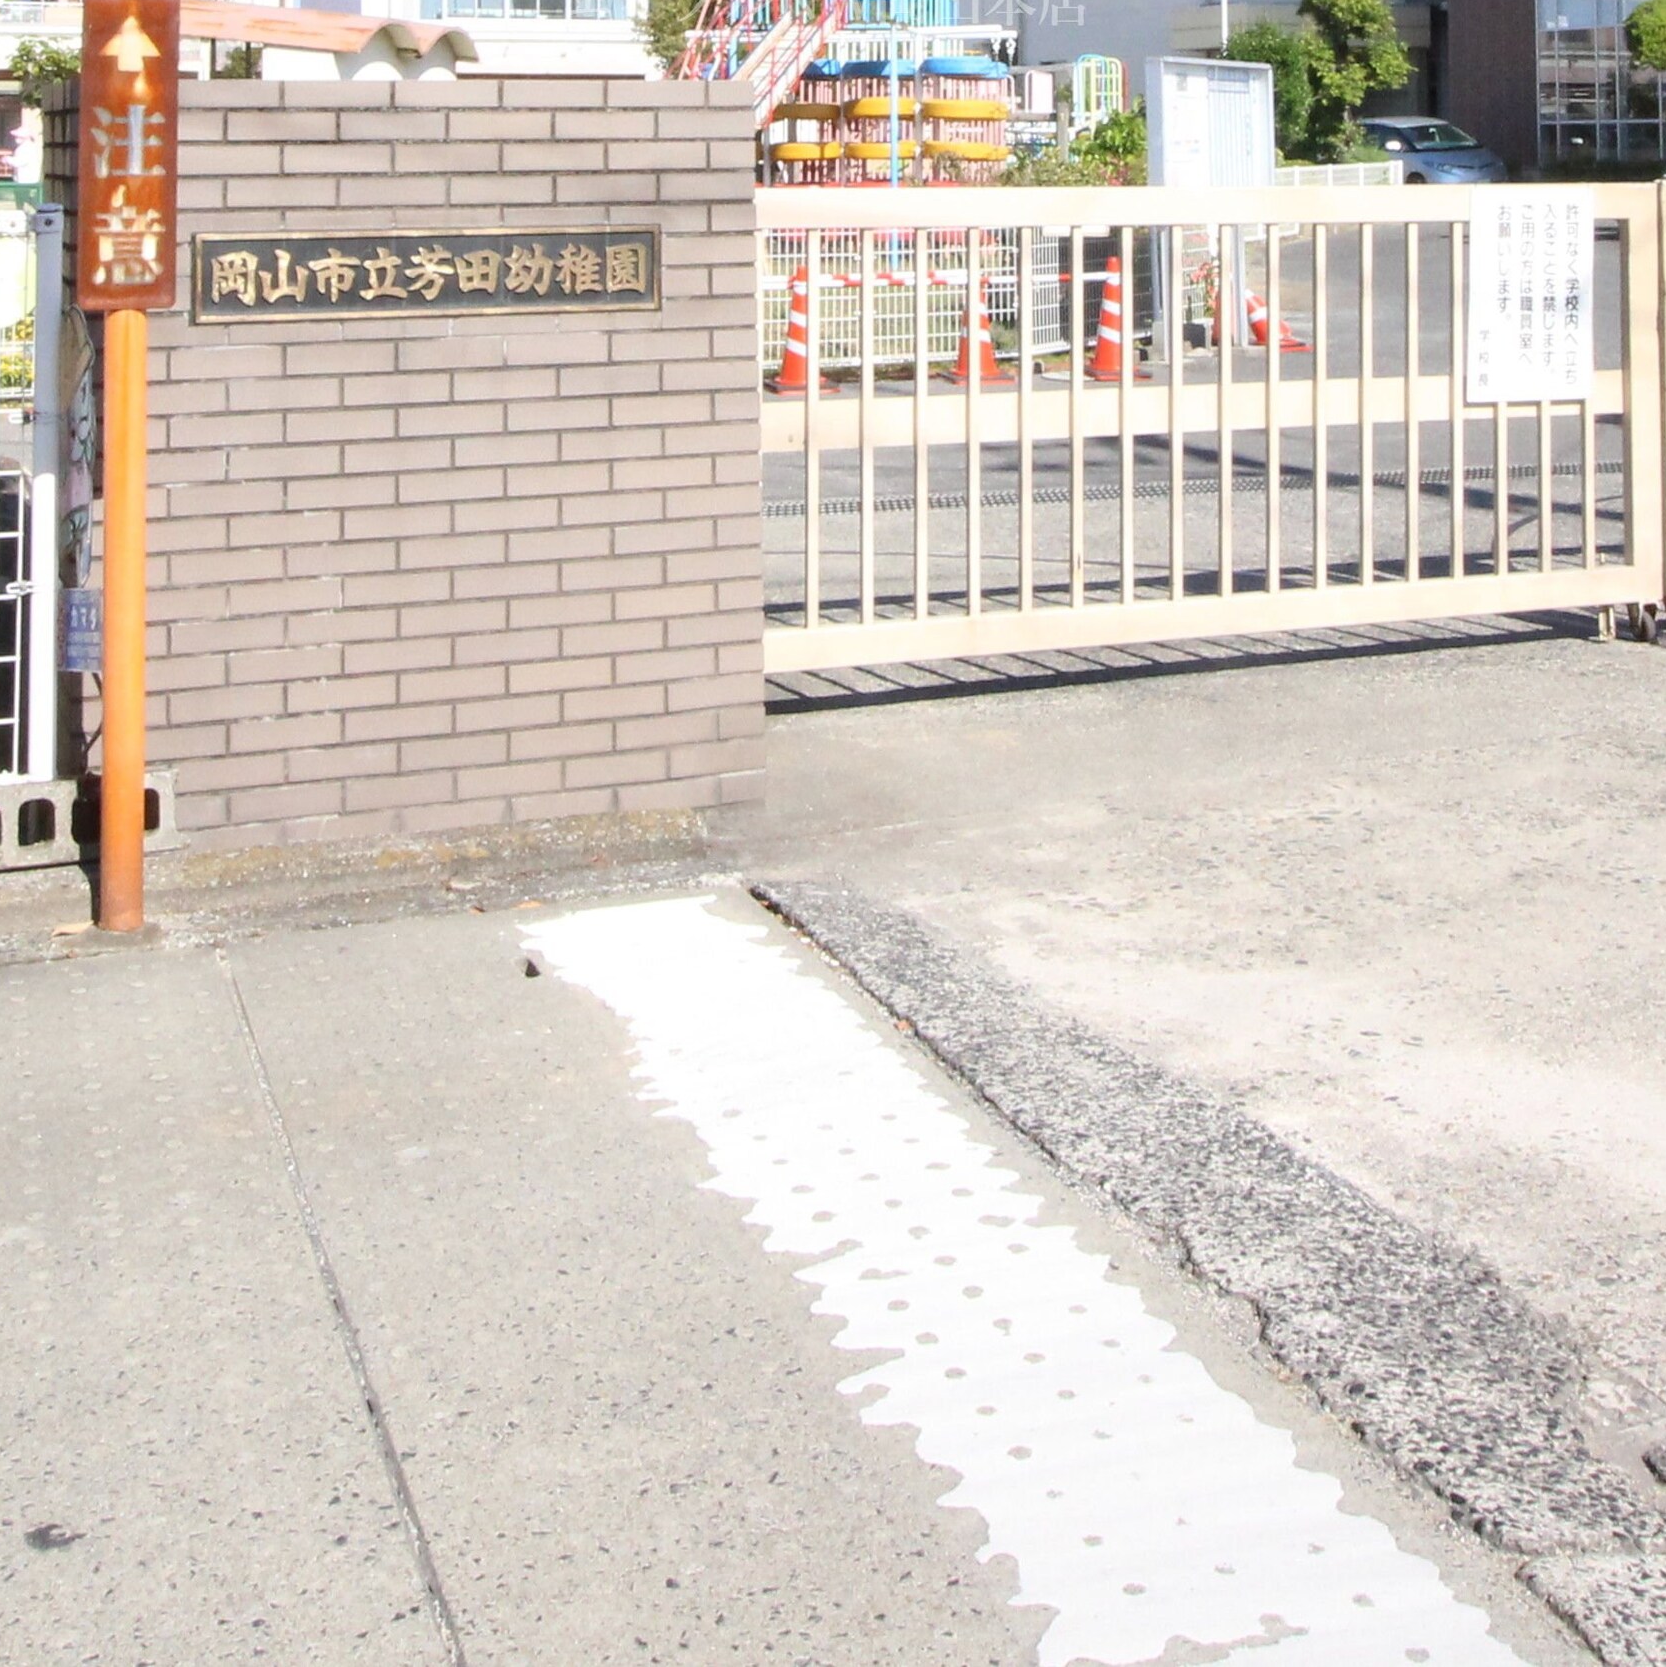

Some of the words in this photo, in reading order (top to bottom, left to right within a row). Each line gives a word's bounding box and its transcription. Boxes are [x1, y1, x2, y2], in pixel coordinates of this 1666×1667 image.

[90, 68, 166, 286] 注意
[210, 240, 647, 307] 岡山市立芳田幼稚園
[1497, 204, 1513, 322] お願いします。
[1519, 203, 1535, 365] ご用の方は職員室へ
[1542, 203, 1558, 374] 入ることを禁じます。
[1564, 203, 1580, 385] 許可なく学校内へ立ち
[1478, 329, 1491, 387] 学校長
